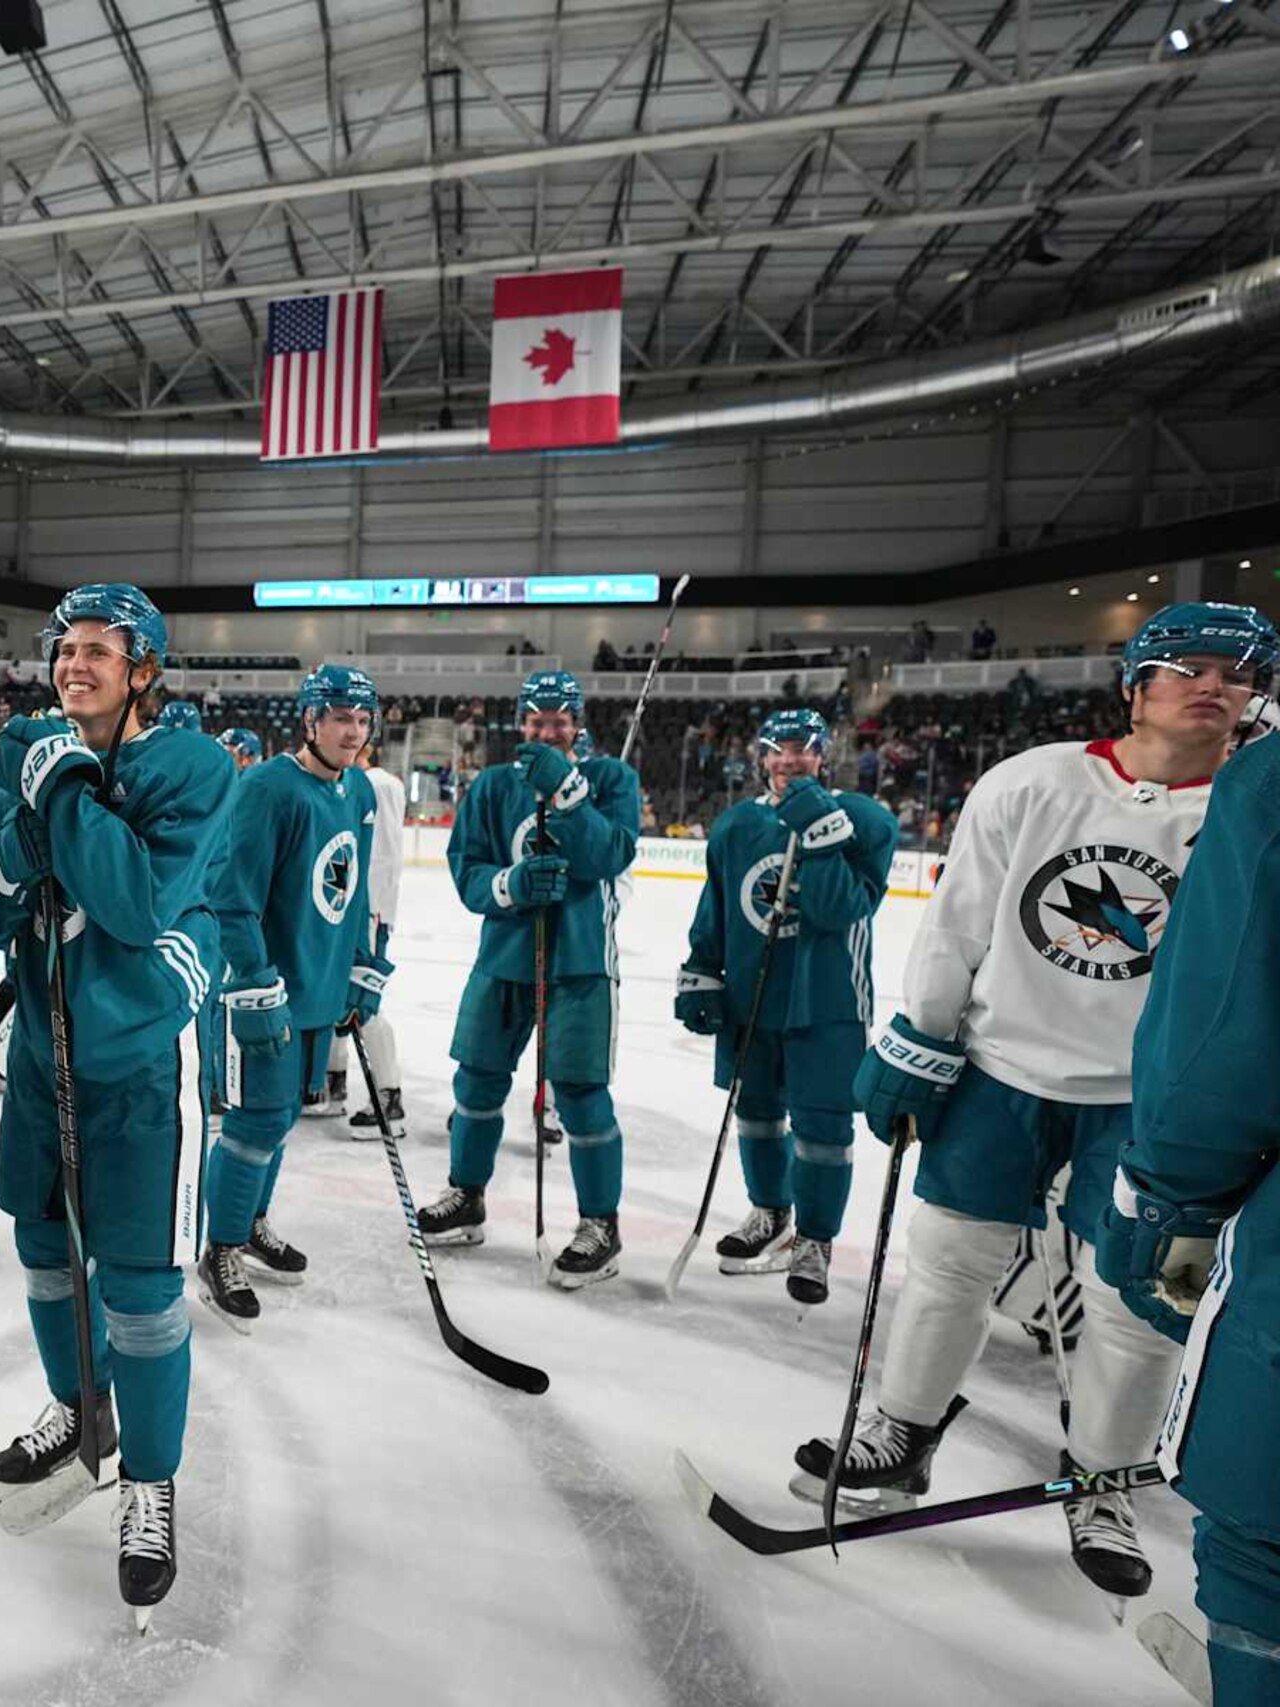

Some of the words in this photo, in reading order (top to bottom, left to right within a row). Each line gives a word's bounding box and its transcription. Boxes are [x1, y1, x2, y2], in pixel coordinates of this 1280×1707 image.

[1200, 627, 1254, 639] CCM
[1064, 845, 1106, 867] SAN
[1118, 848, 1176, 886] JOSE
[1040, 943, 1132, 980] SHARKS
[1167, 1373, 1187, 1443] CCM
[1043, 1461, 1162, 1499] SYNC
